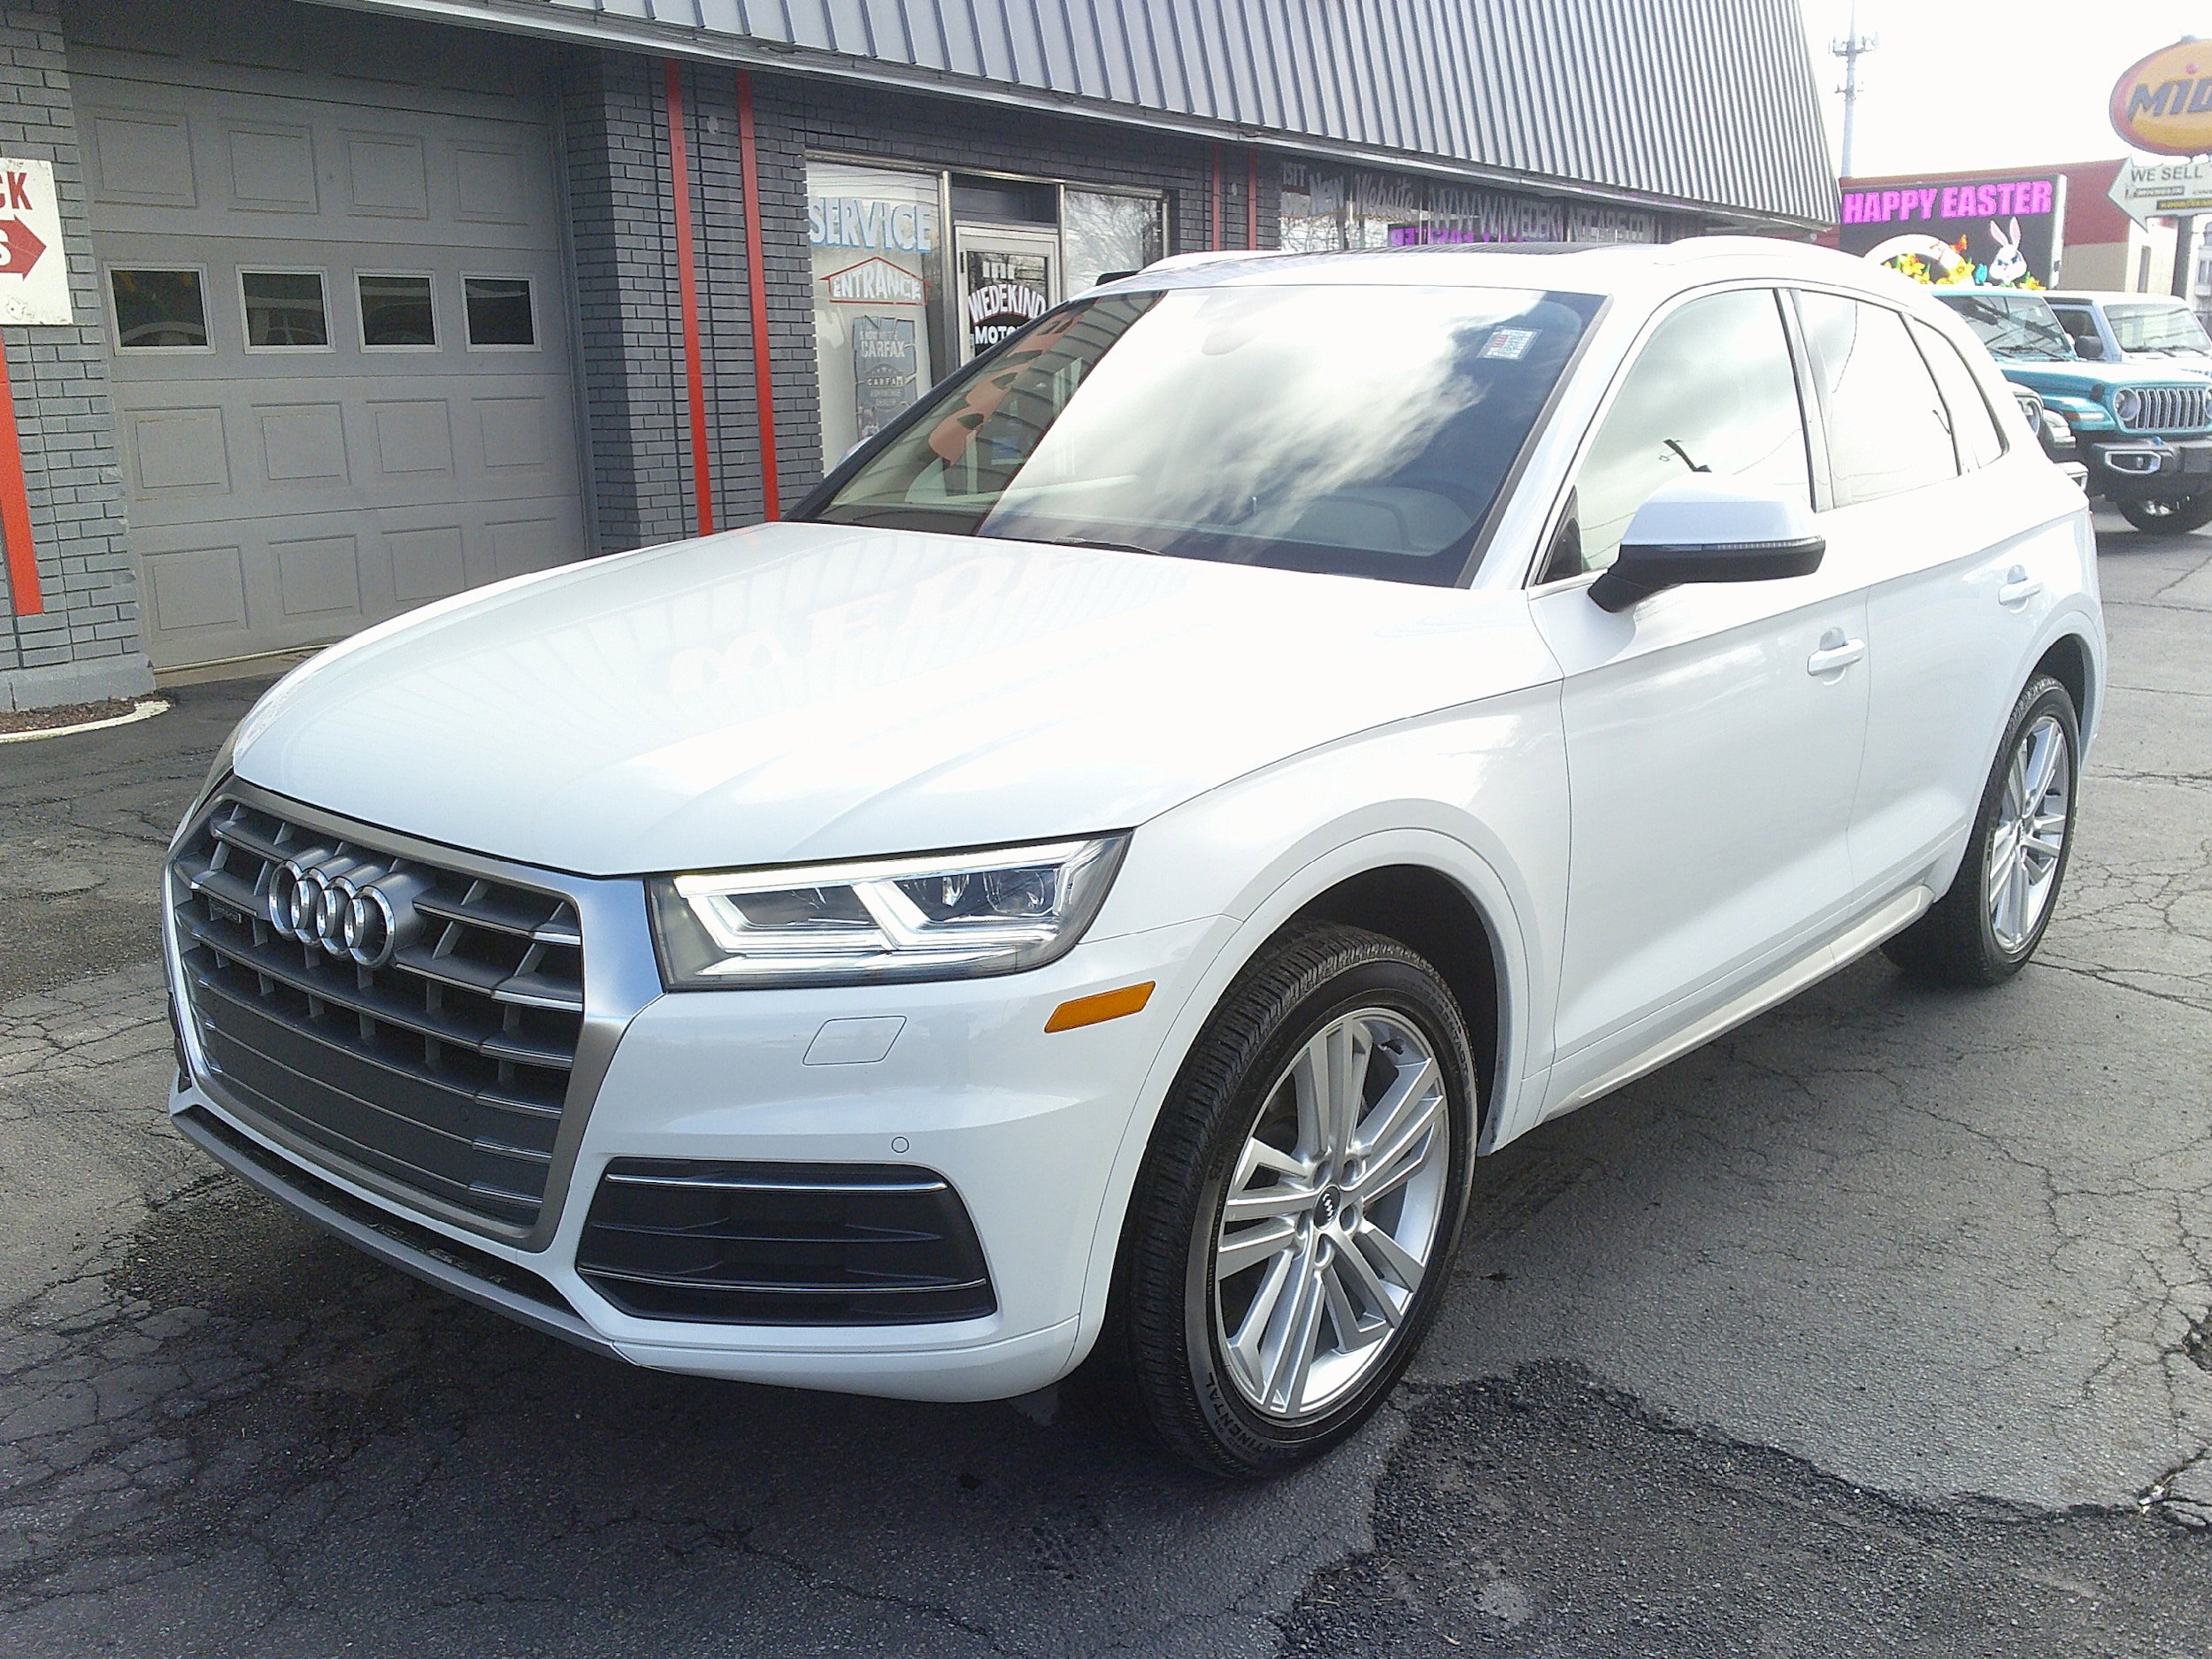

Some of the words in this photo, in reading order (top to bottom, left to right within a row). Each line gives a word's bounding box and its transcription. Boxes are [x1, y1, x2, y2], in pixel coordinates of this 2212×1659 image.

[2131, 168, 2157, 182] WE
[2161, 165, 2203, 181] SELL
[1843, 188, 1938, 225] HAPPY
[1940, 180, 2053, 219] EASTER
[808, 197, 932, 254] SERVICE
[833, 262, 922, 300] ENTRANCE
[968, 284, 1047, 324] WEDEKIND
[861, 340, 905, 357] CARFAX
